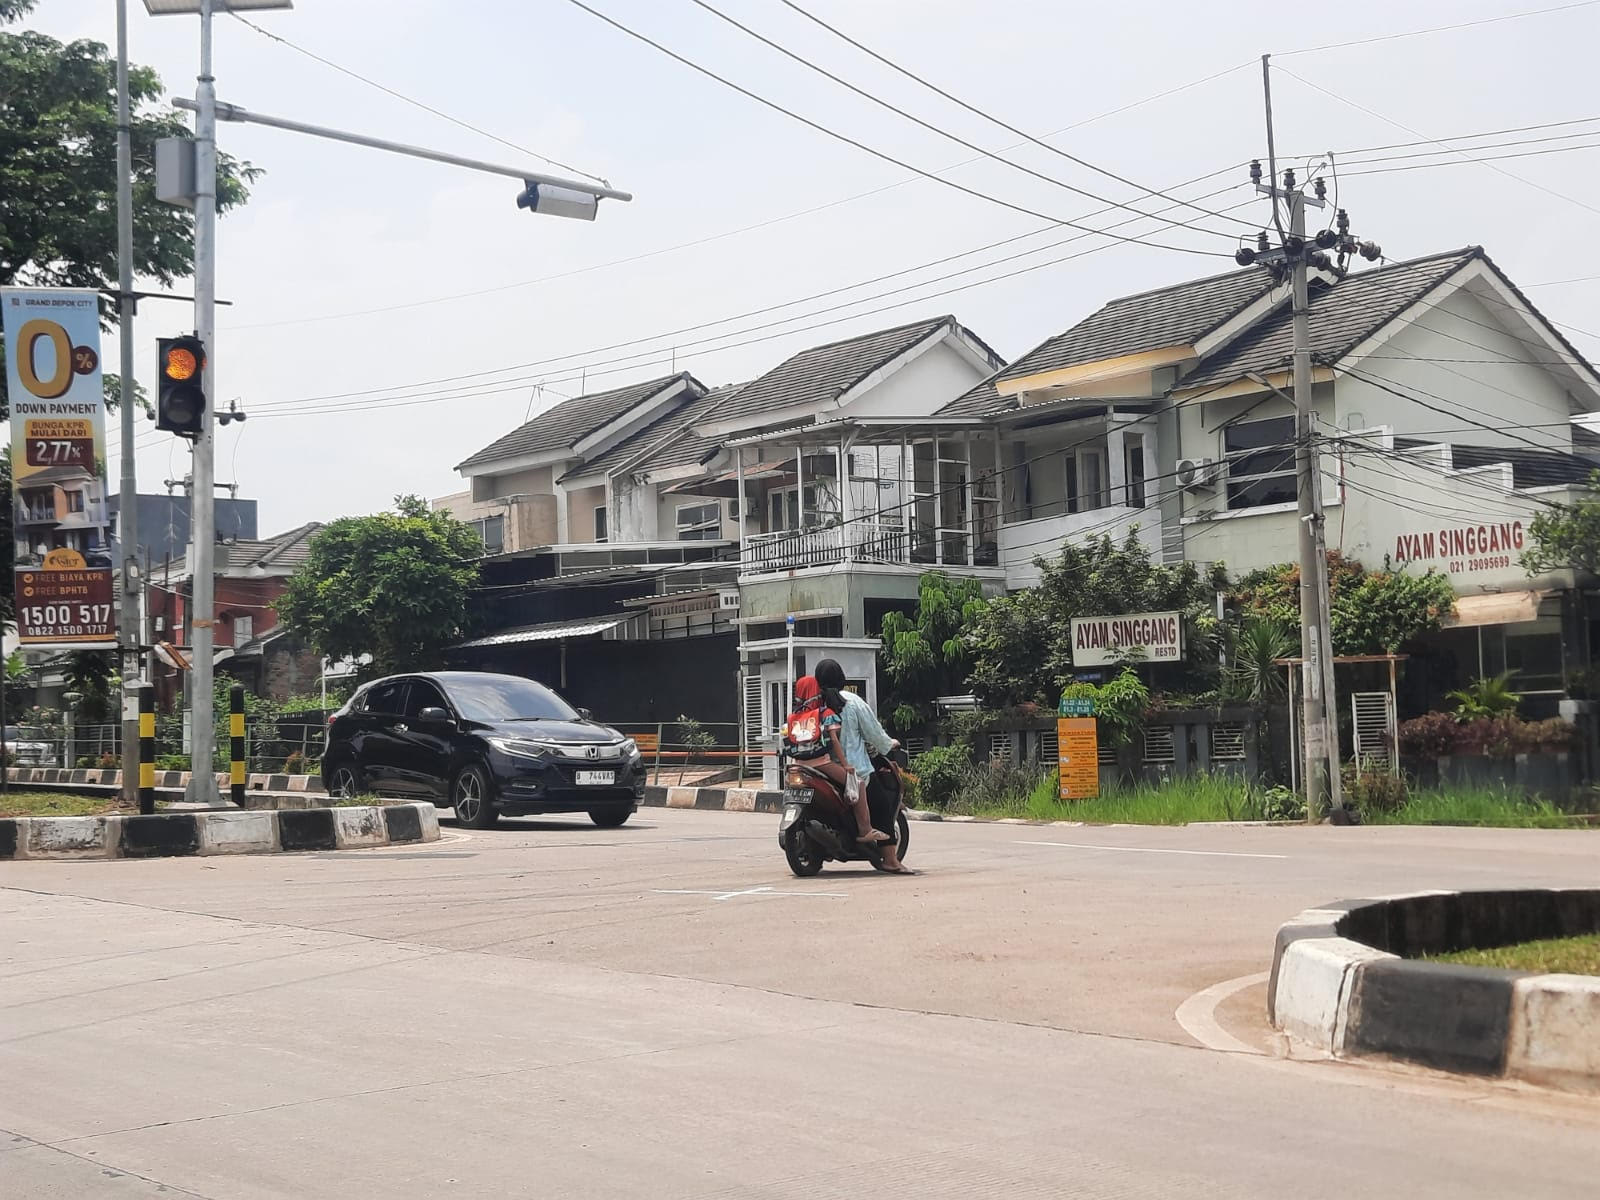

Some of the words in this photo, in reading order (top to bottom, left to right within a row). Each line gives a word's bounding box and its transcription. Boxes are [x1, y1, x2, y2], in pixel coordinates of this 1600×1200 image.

[25, 298, 51, 306] GRAND
[16, 403, 47, 414] DOWN
[49, 403, 97, 414] PAYMENT
[31, 421, 65, 429] BUNGA
[67, 421, 85, 429] KPR
[31, 429, 61, 437] MULAI
[63, 429, 87, 437] DARI
[1395, 532, 1435, 562] AYAM
[1439, 521, 1523, 558] SINGGANG
[1449, 560, 1465, 574] 021
[1468, 555, 1510, 572] 29095699
[35, 573, 57, 582] FREE
[59, 573, 84, 582] BIAYA
[87, 572, 104, 581] KPR
[35, 586, 57, 595] FREE
[59, 585, 88, 595] BPHTB
[21, 605, 71, 626] 1500
[79, 604, 111, 624] 517
[28, 626, 55, 636] 0822
[58, 625, 83, 635] 1500
[87, 624, 108, 634] 1717
[1076, 622, 1110, 650] AYAM
[1112, 617, 1177, 648] SINGGANG
[1154, 646, 1177, 657] RESTO
